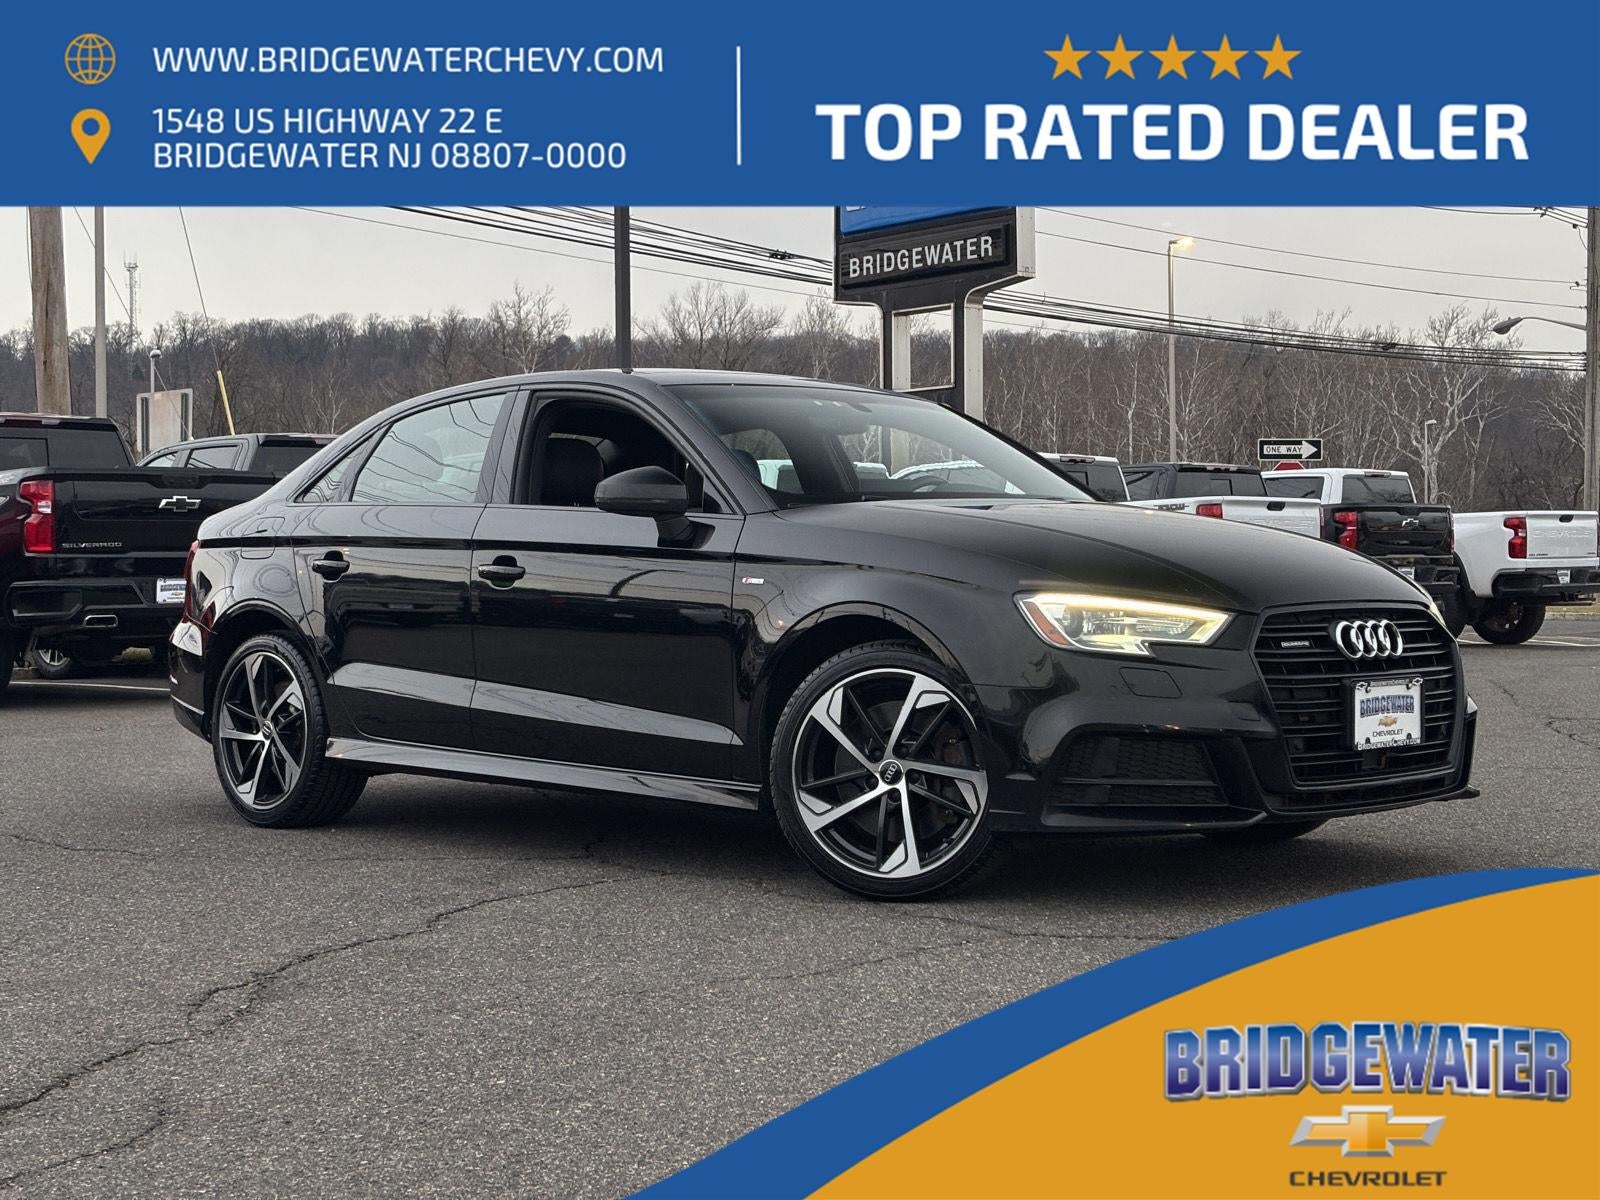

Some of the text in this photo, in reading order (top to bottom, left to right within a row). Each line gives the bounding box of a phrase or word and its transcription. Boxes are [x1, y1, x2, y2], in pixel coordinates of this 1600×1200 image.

[849, 235, 993, 279] BRIDGEWATER
[1360, 695, 1415, 719] BRIDGEWATER
[1372, 728, 1404, 738] CHEVROLET
